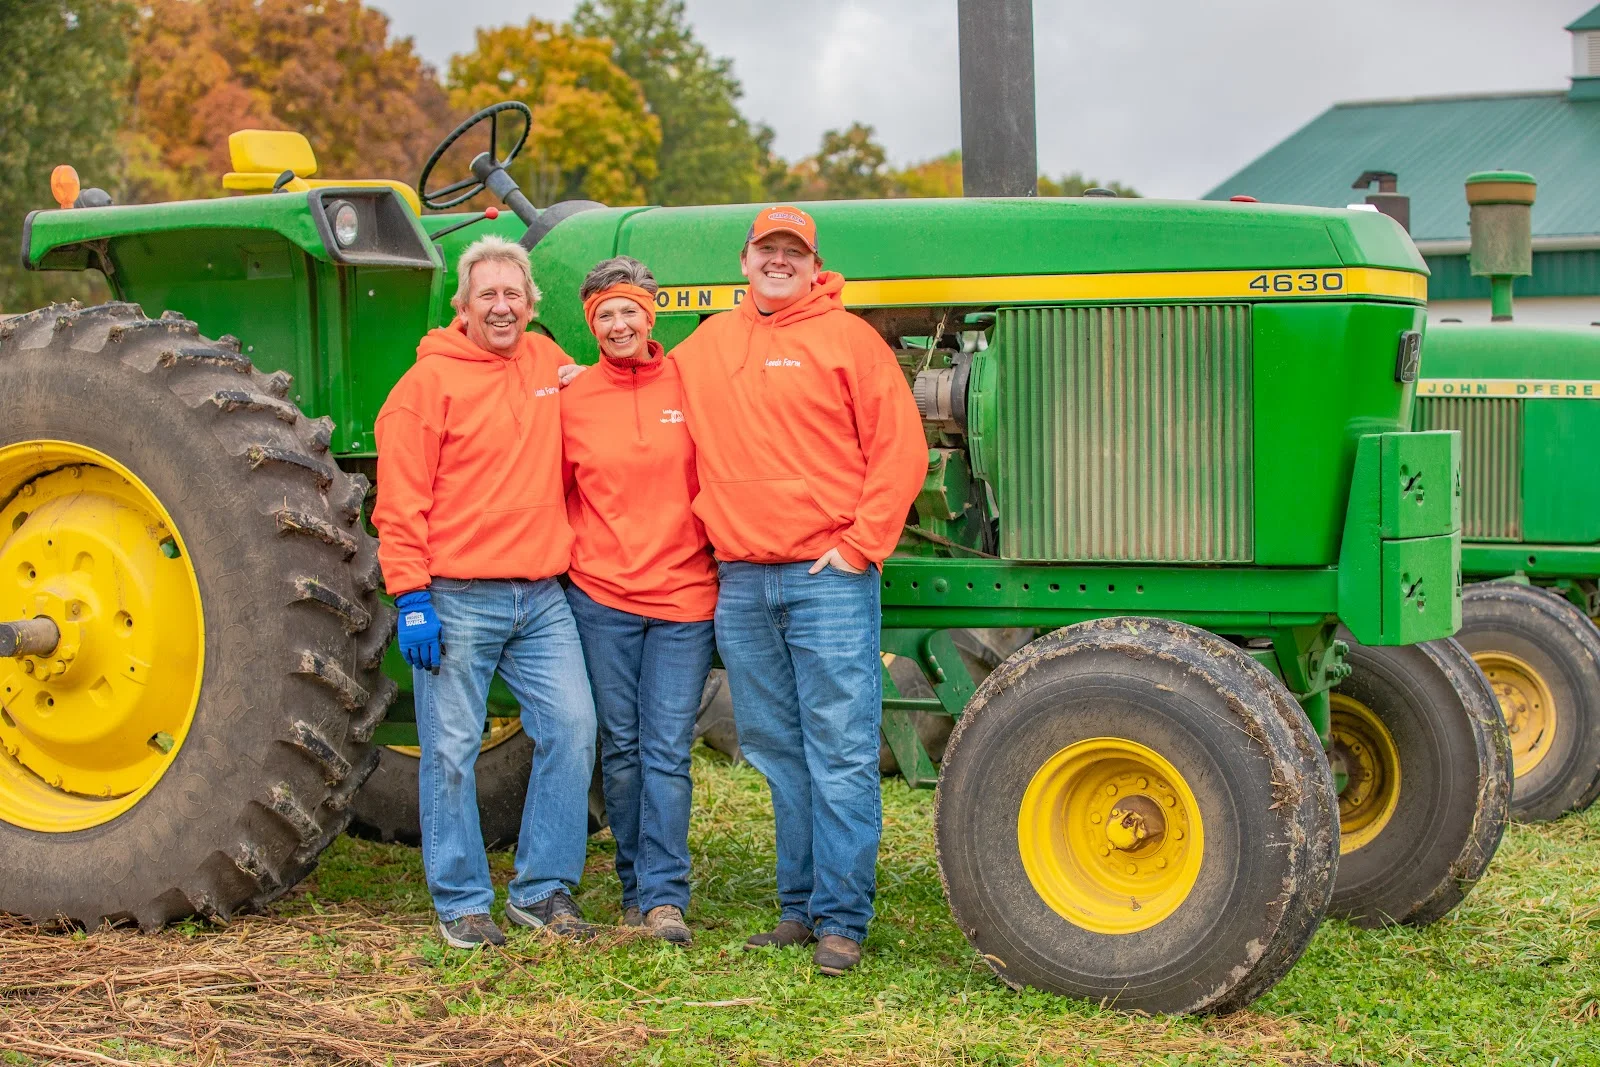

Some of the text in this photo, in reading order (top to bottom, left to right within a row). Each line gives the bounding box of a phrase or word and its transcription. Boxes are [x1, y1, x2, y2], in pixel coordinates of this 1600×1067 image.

[1249, 272, 1343, 293] 4630
[655, 290, 712, 308] OHN
[783, 358, 801, 368] Farm
[1427, 383, 1593, 396] JOHN DEERE
